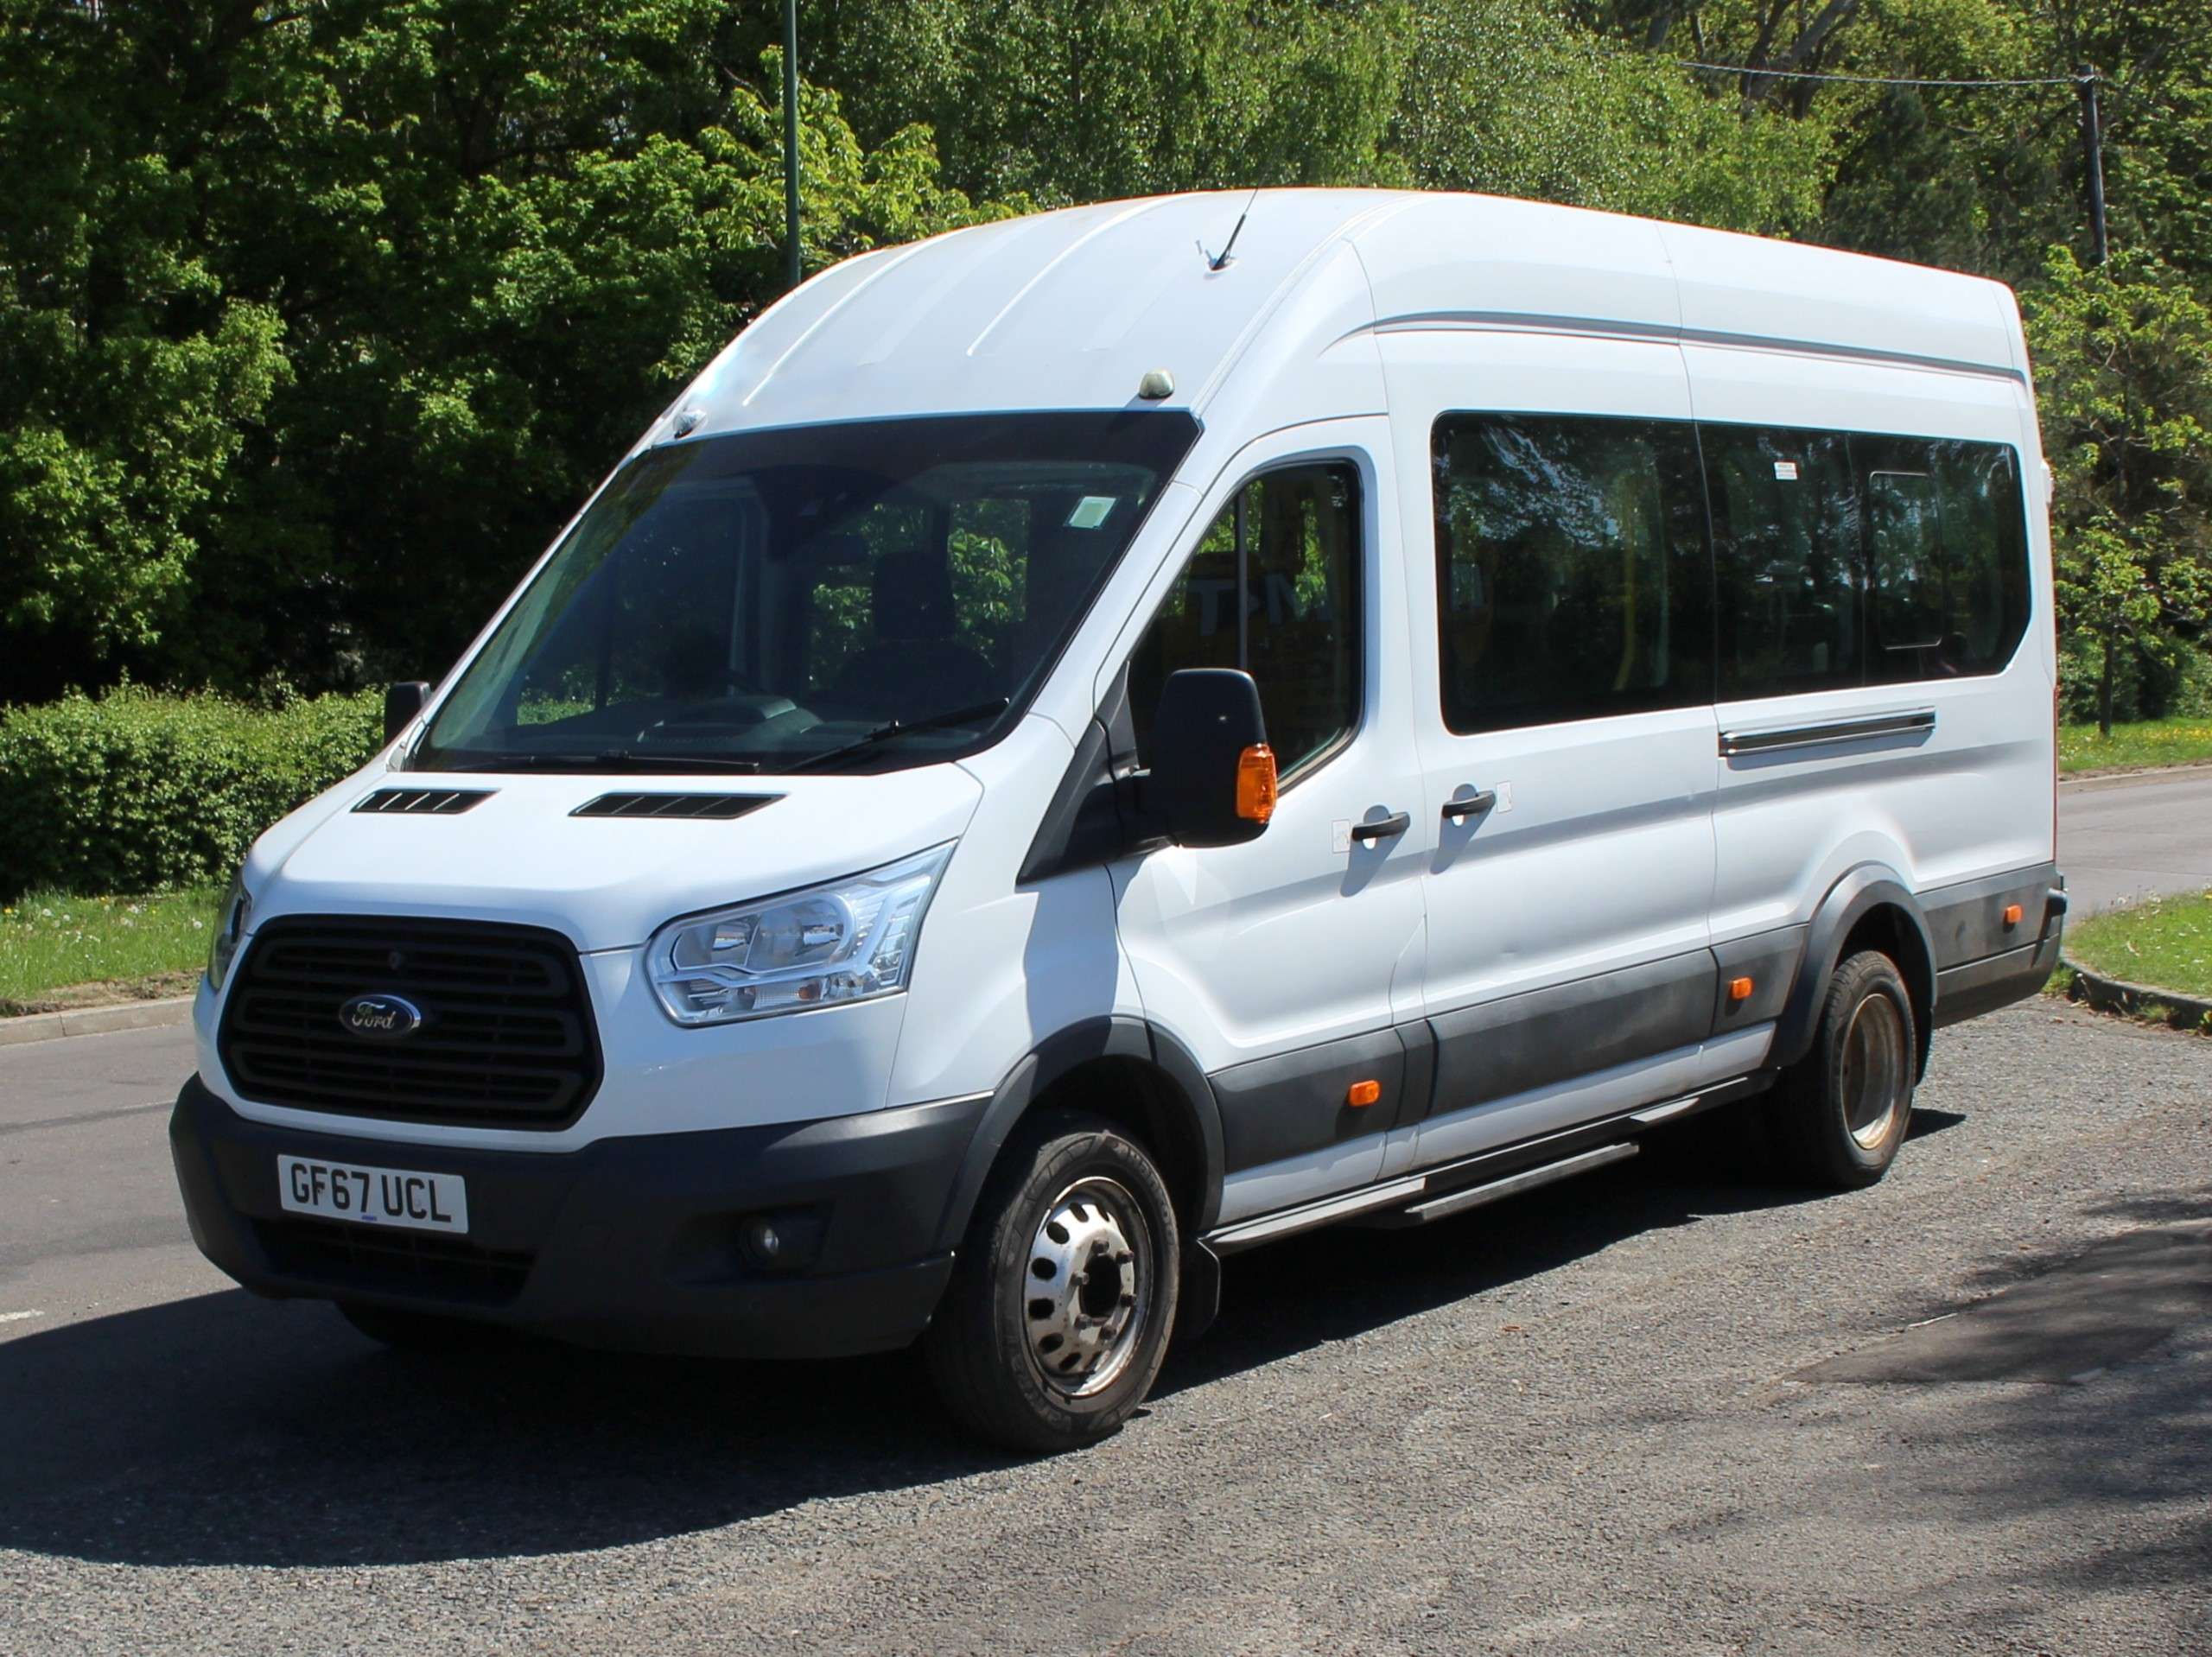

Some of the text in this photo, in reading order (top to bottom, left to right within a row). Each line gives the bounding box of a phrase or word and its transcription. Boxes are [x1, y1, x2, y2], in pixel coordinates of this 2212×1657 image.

[352, 1001, 396, 1030] Ford
[290, 1163, 452, 1223] GF67 UCL
